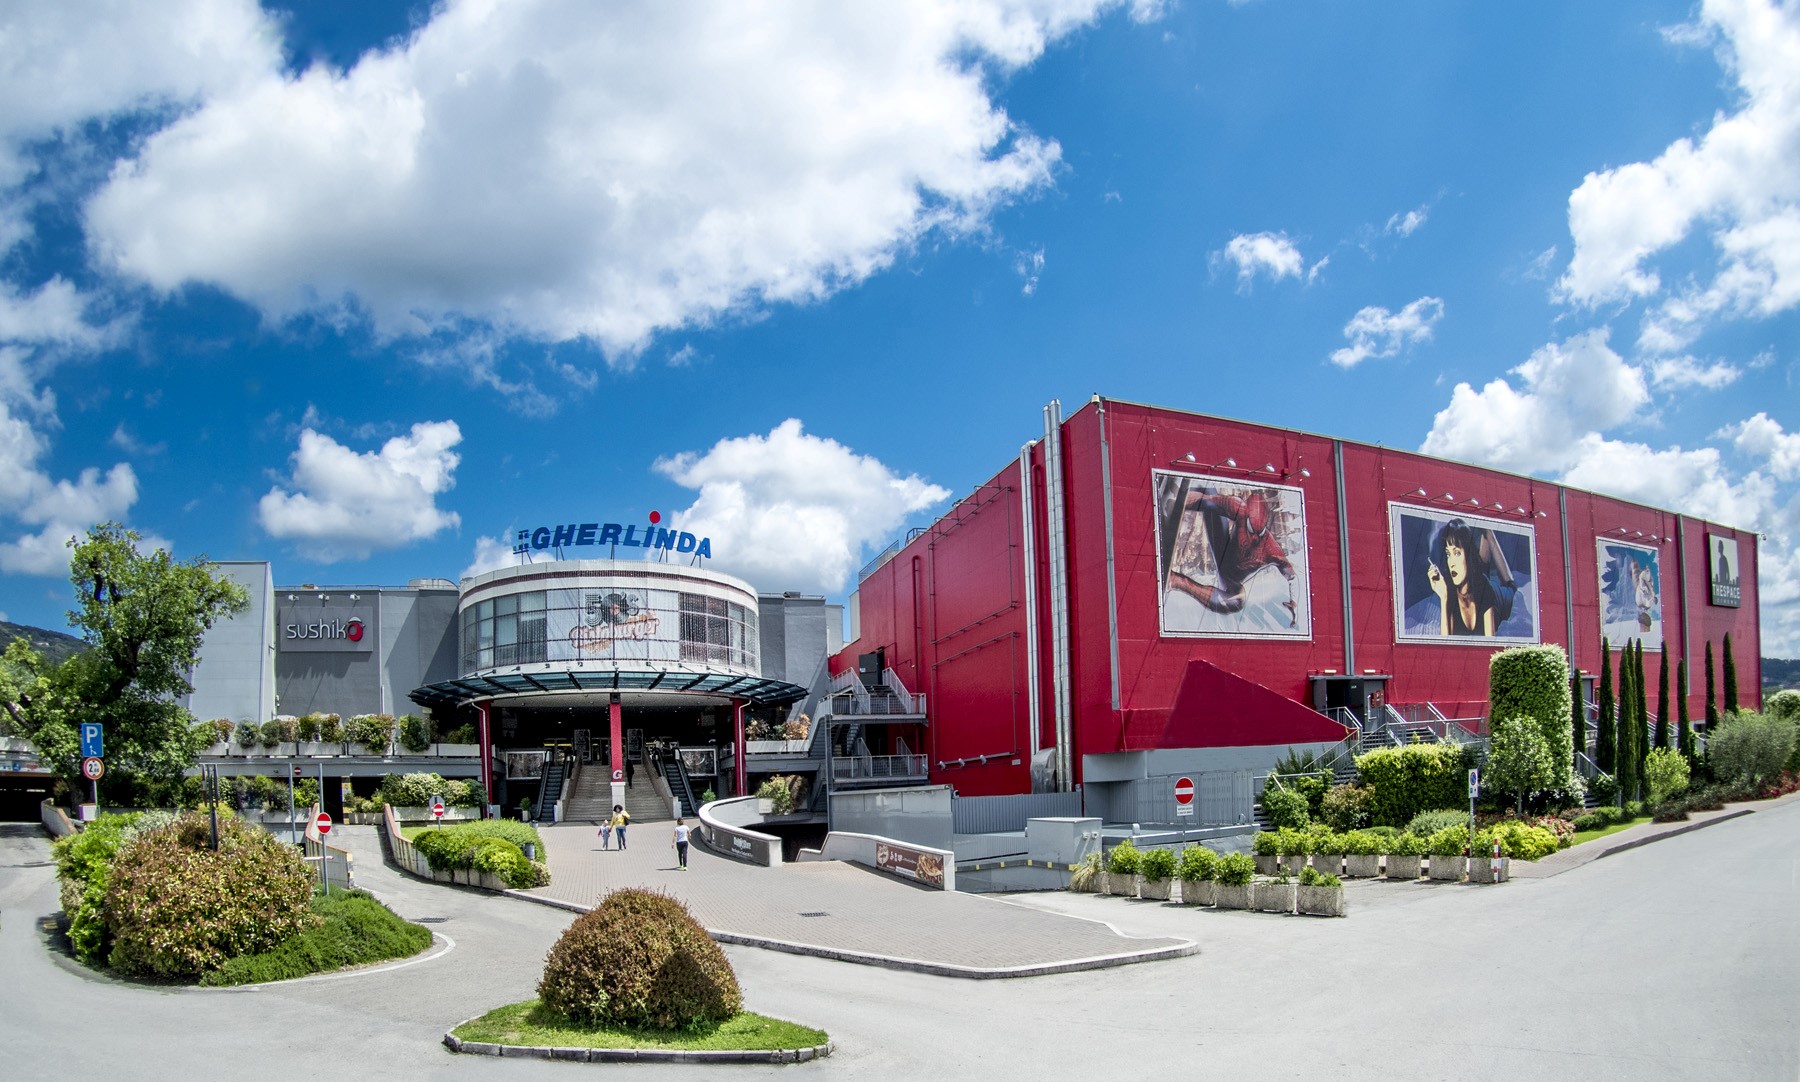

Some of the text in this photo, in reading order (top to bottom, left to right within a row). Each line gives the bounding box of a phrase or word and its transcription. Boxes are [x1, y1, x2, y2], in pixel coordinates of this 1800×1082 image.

[531, 512, 711, 559] GHERLINDA
[86, 726, 98, 743] P
[612, 769, 622, 779] G
